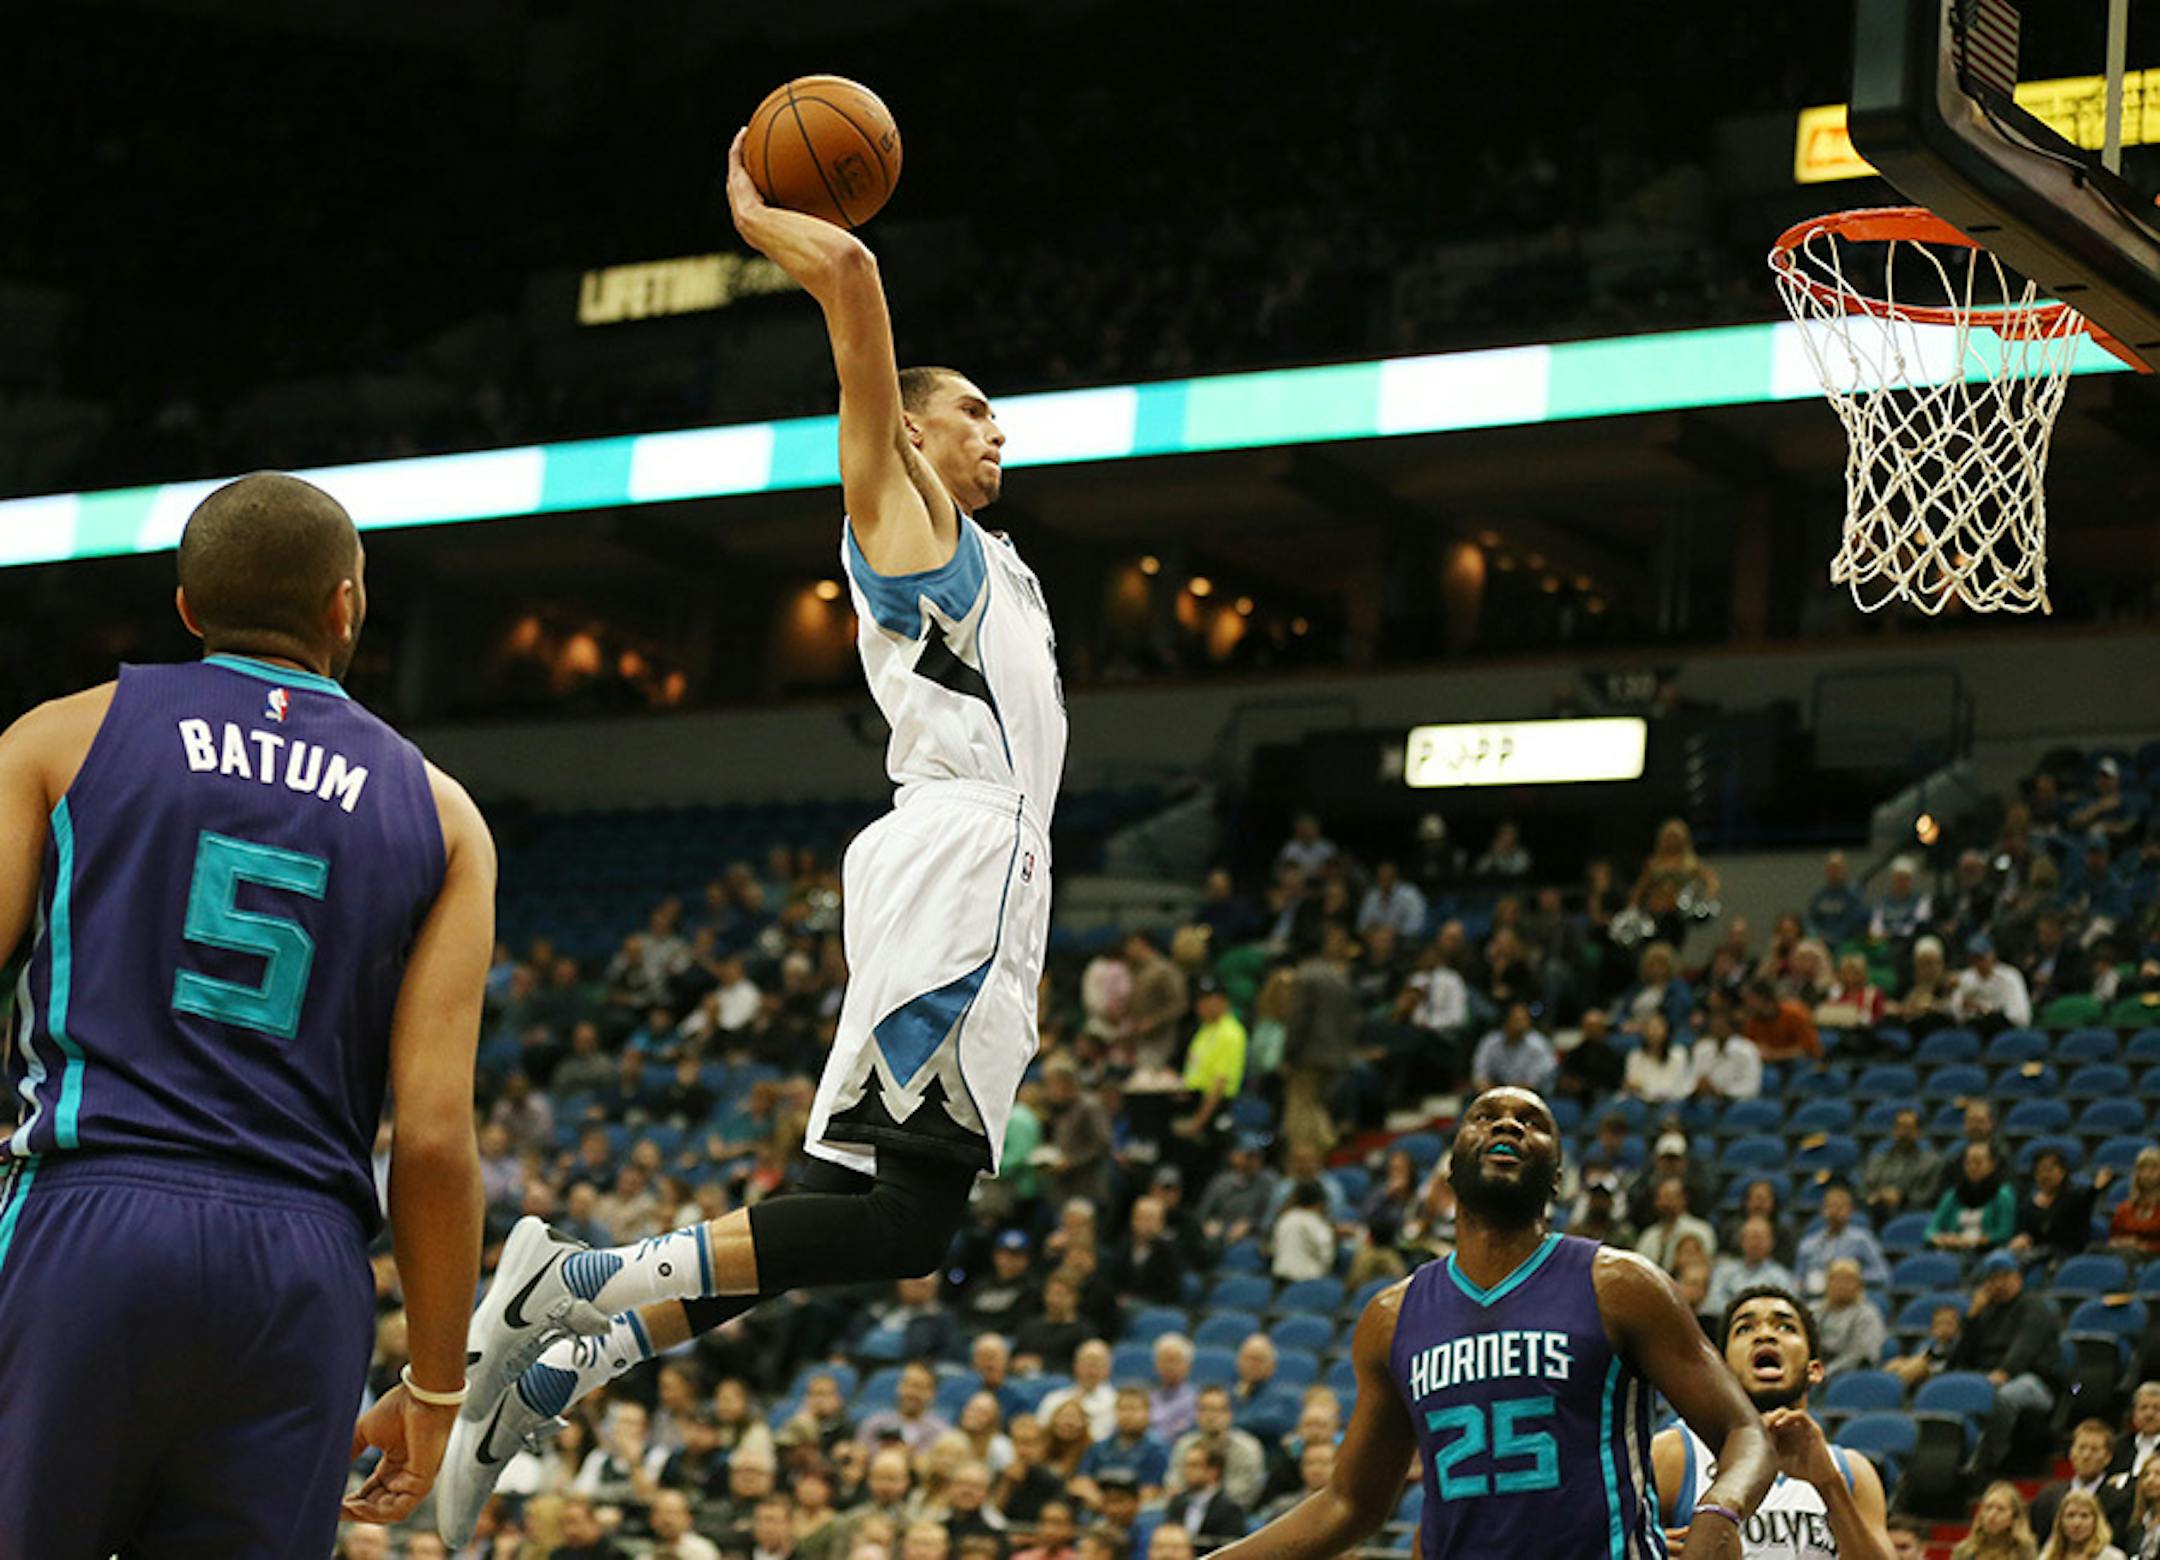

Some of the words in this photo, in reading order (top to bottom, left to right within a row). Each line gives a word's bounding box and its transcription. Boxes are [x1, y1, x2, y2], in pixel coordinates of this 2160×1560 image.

[178, 718, 369, 813] BATUM
[171, 829, 331, 1041] 5
[1409, 1330, 1575, 1401] HORNETS
[1424, 1395, 1562, 1502] 25
